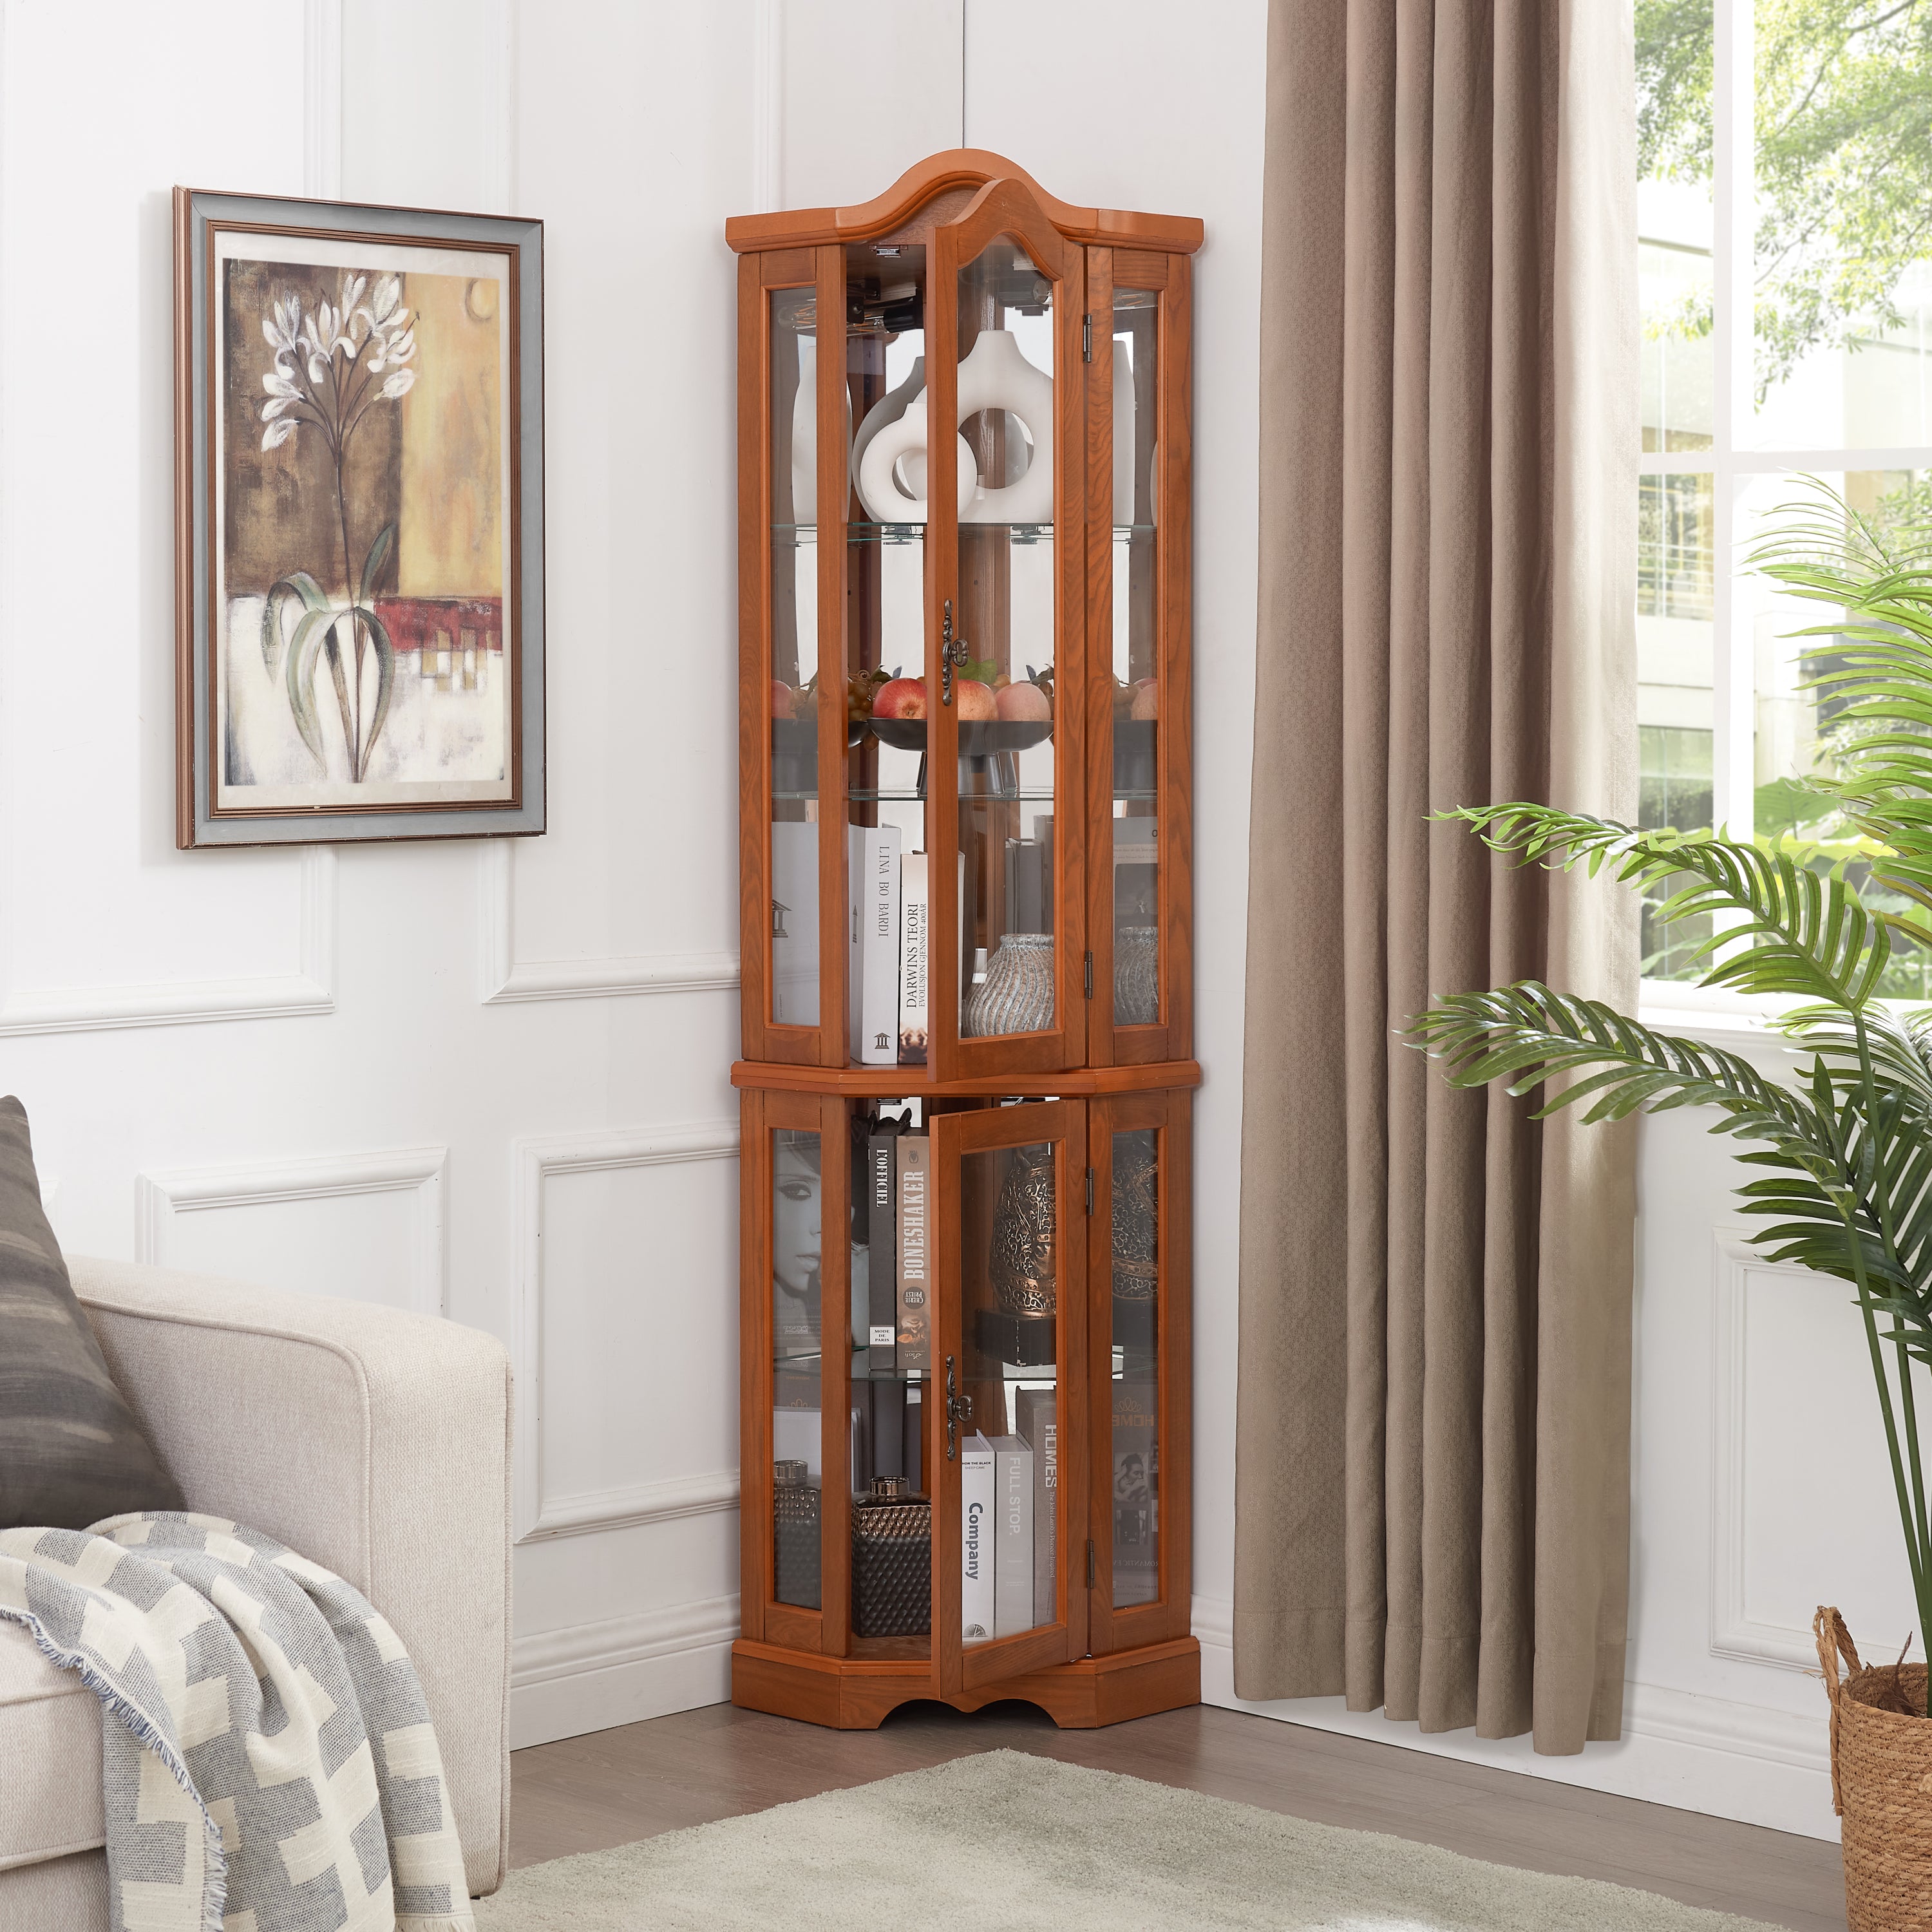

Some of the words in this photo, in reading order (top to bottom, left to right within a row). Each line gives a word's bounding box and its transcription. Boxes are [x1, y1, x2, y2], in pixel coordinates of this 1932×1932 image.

[879, 846, 890, 874] LINA
[878, 882, 889, 896] BO
[878, 903, 889, 938] BARDI
[907, 904, 918, 943] TEORI
[919, 927, 928, 963] GJENNOM
[906, 947, 918, 1008] DARWINS
[918, 965, 927, 1007] EVOLUSJON
[876, 1148, 888, 1208] L'OFFICIEL
[903, 1171, 925, 1280] BONESHAKER
[1009, 1457, 1021, 1493] FULL
[1045, 1425, 1057, 1488] HOMES
[1009, 1497, 1021, 1535] STOP.
[965, 1502, 983, 1580] Company
